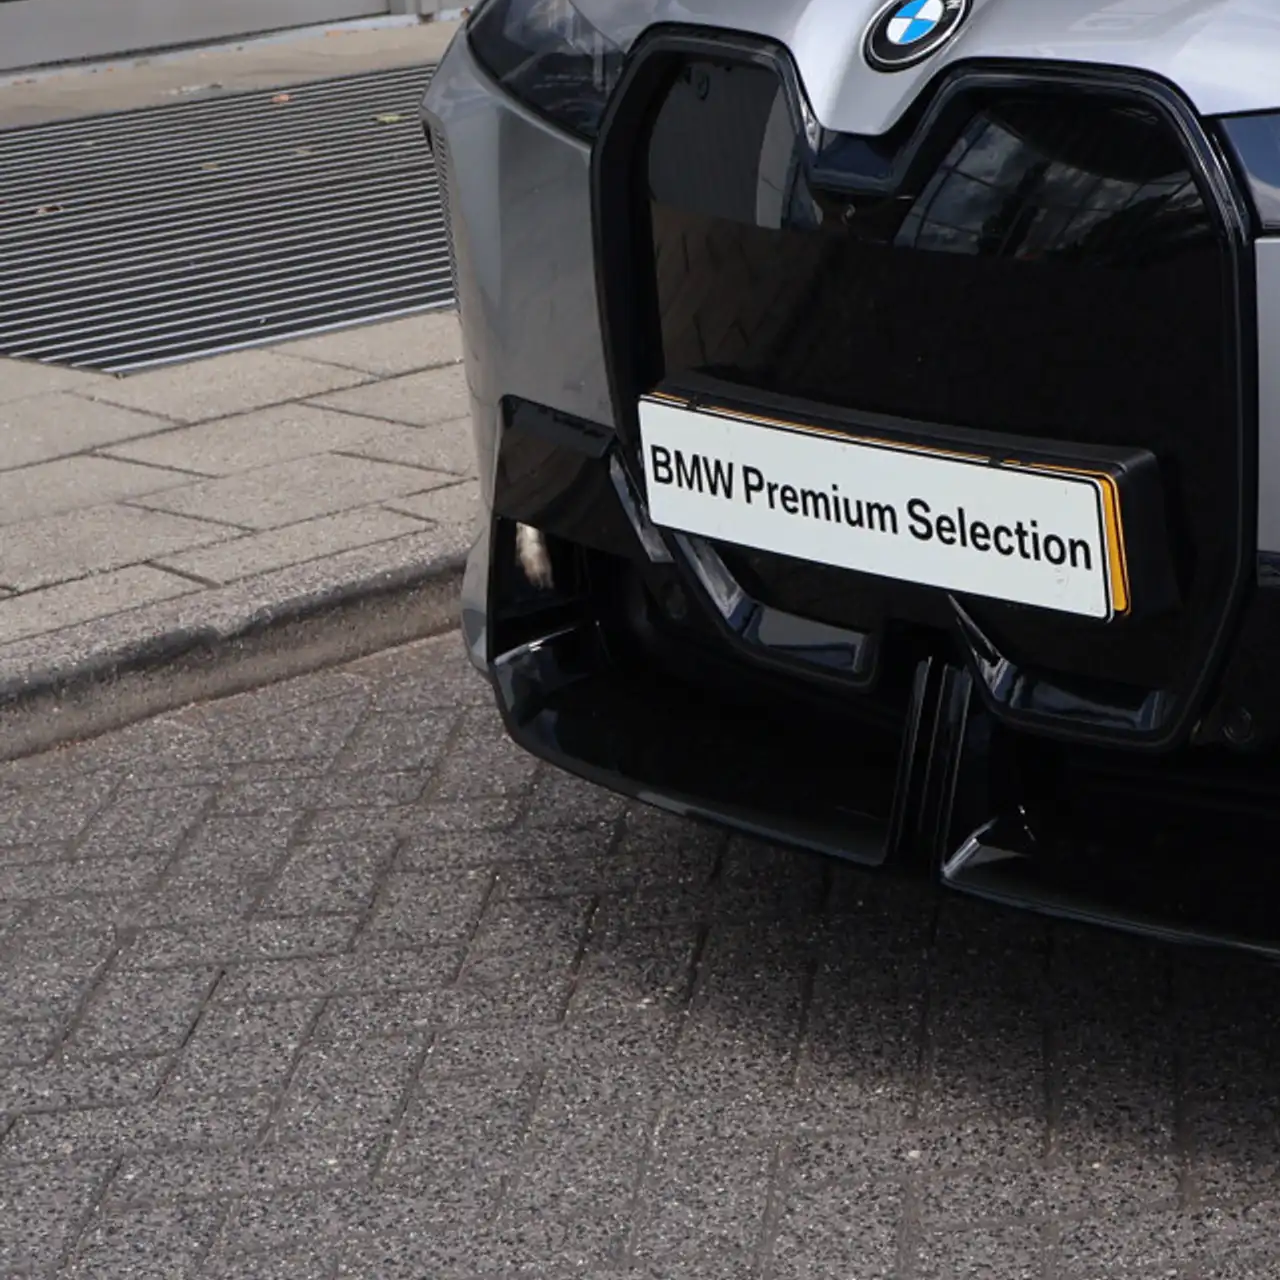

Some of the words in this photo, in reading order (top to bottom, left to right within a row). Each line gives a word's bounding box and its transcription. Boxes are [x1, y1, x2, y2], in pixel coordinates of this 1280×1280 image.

[651, 445, 733, 499] BMW
[743, 466, 897, 534] Premium
[908, 499, 1091, 569] Selection
